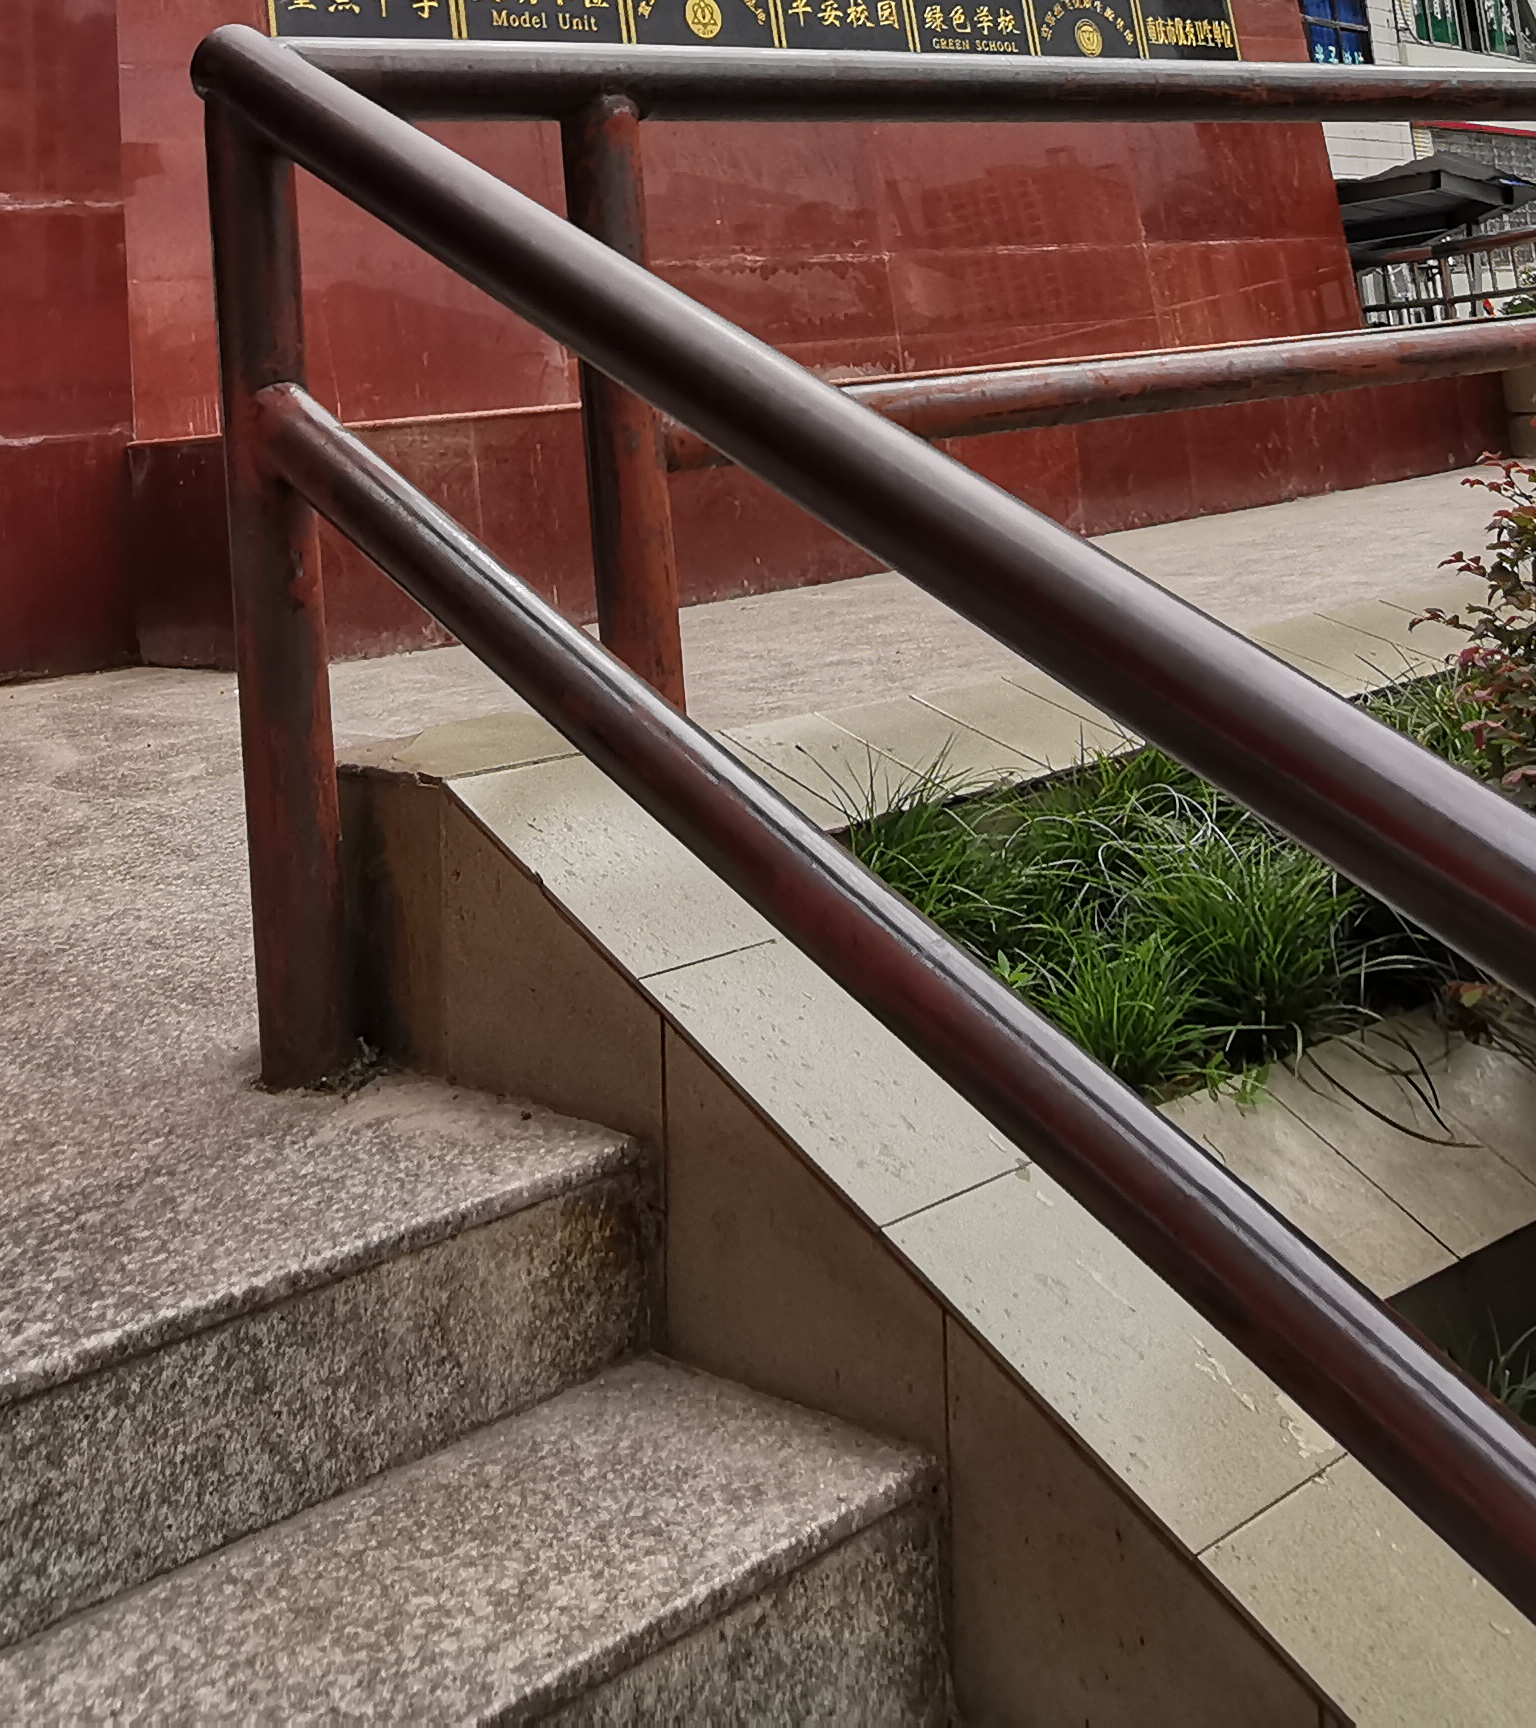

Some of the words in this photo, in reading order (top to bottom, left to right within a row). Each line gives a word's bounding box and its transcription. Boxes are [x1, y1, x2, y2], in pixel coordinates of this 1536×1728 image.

[491, 9, 548, 30] Model
[558, 13, 599, 32] Unit
[924, 5, 1022, 35] 绿色学校
[1146, 16, 1234, 48] 重庆市优秀卫生单位
[932, 37, 971, 51] GREEN
[975, 39, 1019, 53] SCHOOL
